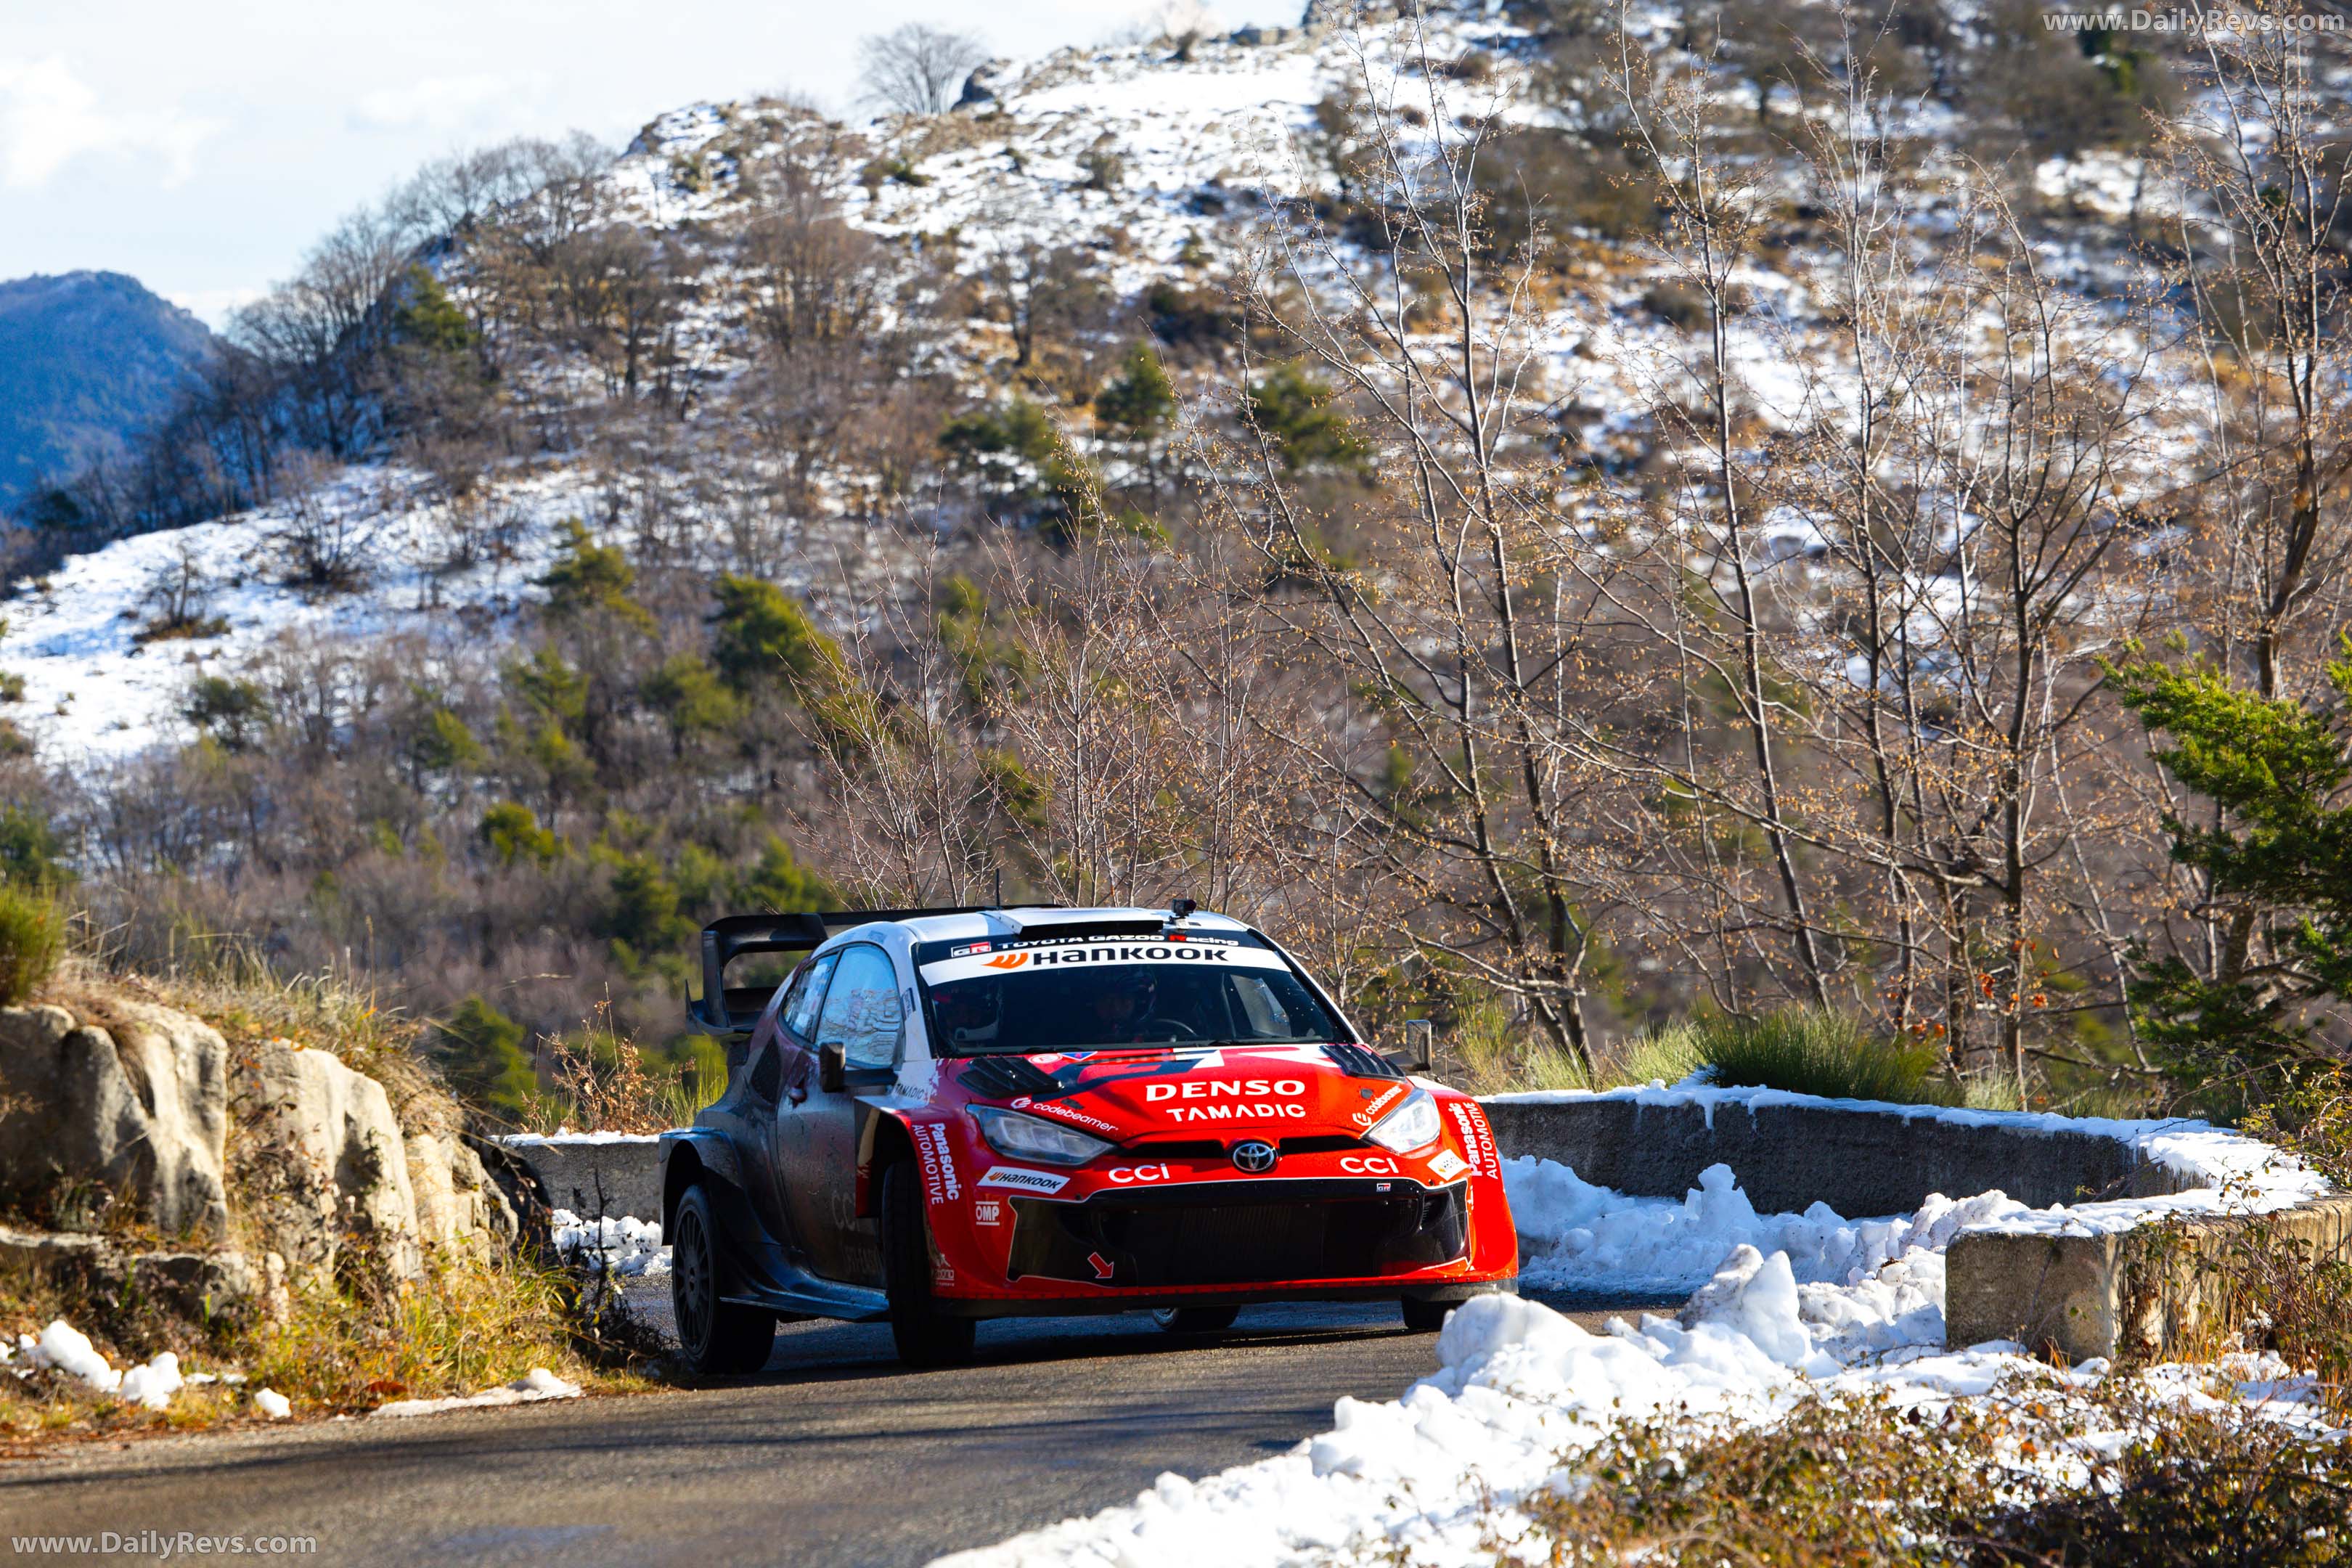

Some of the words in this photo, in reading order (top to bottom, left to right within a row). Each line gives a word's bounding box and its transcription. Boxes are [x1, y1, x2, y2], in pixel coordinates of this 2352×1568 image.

[952, 944, 991, 957] GR
[997, 935, 1084, 950] TOYOTA
[1169, 934, 1239, 947] Racing
[1145, 1079, 1306, 1102] DENSO
[1033, 1101, 1116, 1132] codebeamer
[1165, 1103, 1307, 1122] TAMADIC
[1447, 1103, 1483, 1177] Panasonic
[1463, 1101, 1499, 1180] AUTOMOTIVE
[911, 1124, 944, 1206] AUTOMOTIVE
[928, 1122, 963, 1201] Panasonic
[1339, 1156, 1400, 1175] CCI
[1108, 1163, 1170, 1183] CCI
[975, 1205, 1000, 1222] OMP
